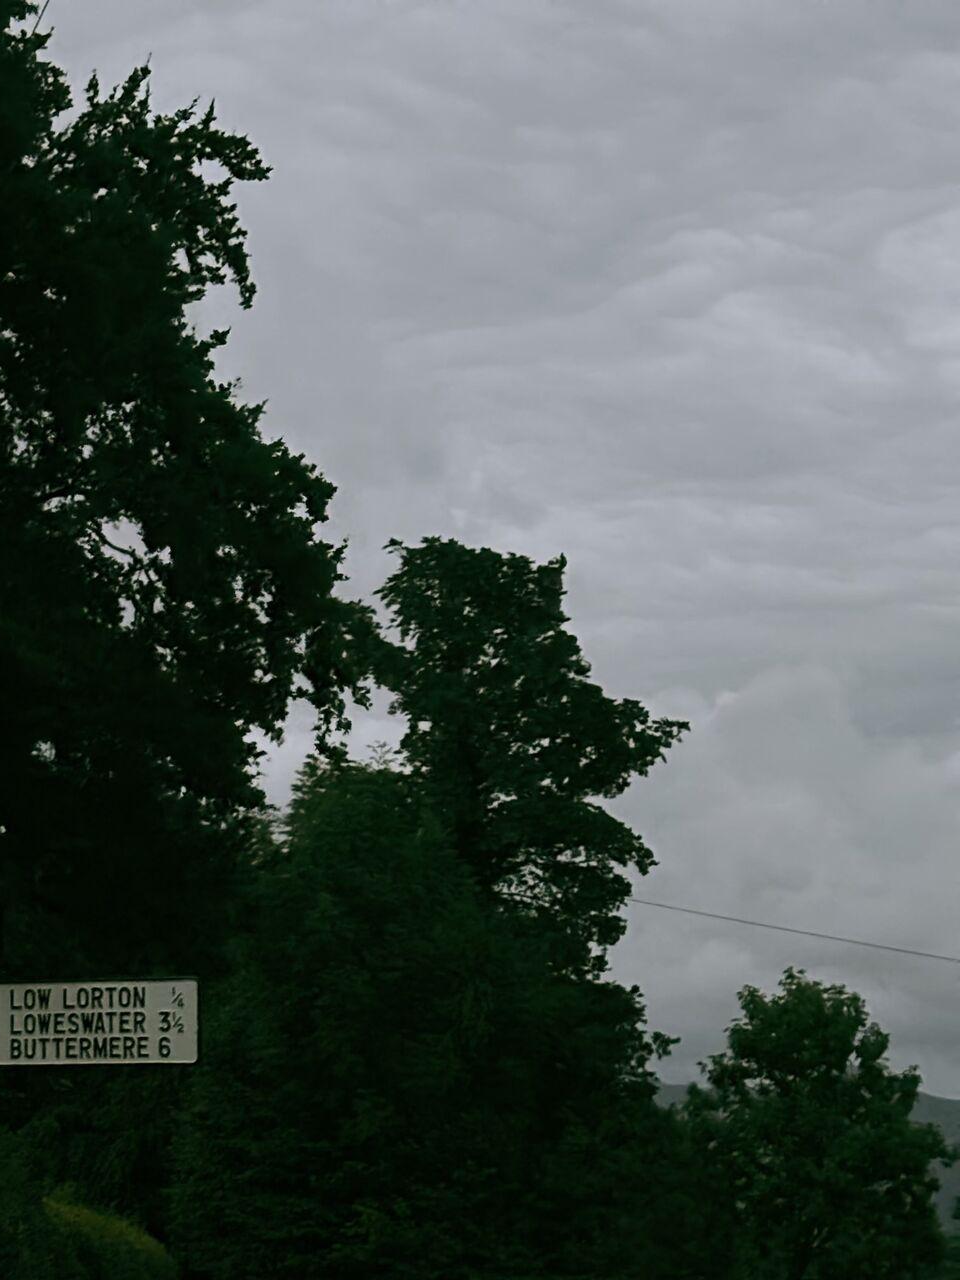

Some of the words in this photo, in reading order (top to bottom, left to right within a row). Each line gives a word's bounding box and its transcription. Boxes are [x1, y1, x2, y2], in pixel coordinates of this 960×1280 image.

[9, 987, 51, 1010] LOW
[62, 986, 146, 1009] LORTON
[9, 1011, 146, 1035] LOWESWATER
[9, 1036, 149, 1060] BUTTERMERE
[157, 1037, 172, 1059] 6
